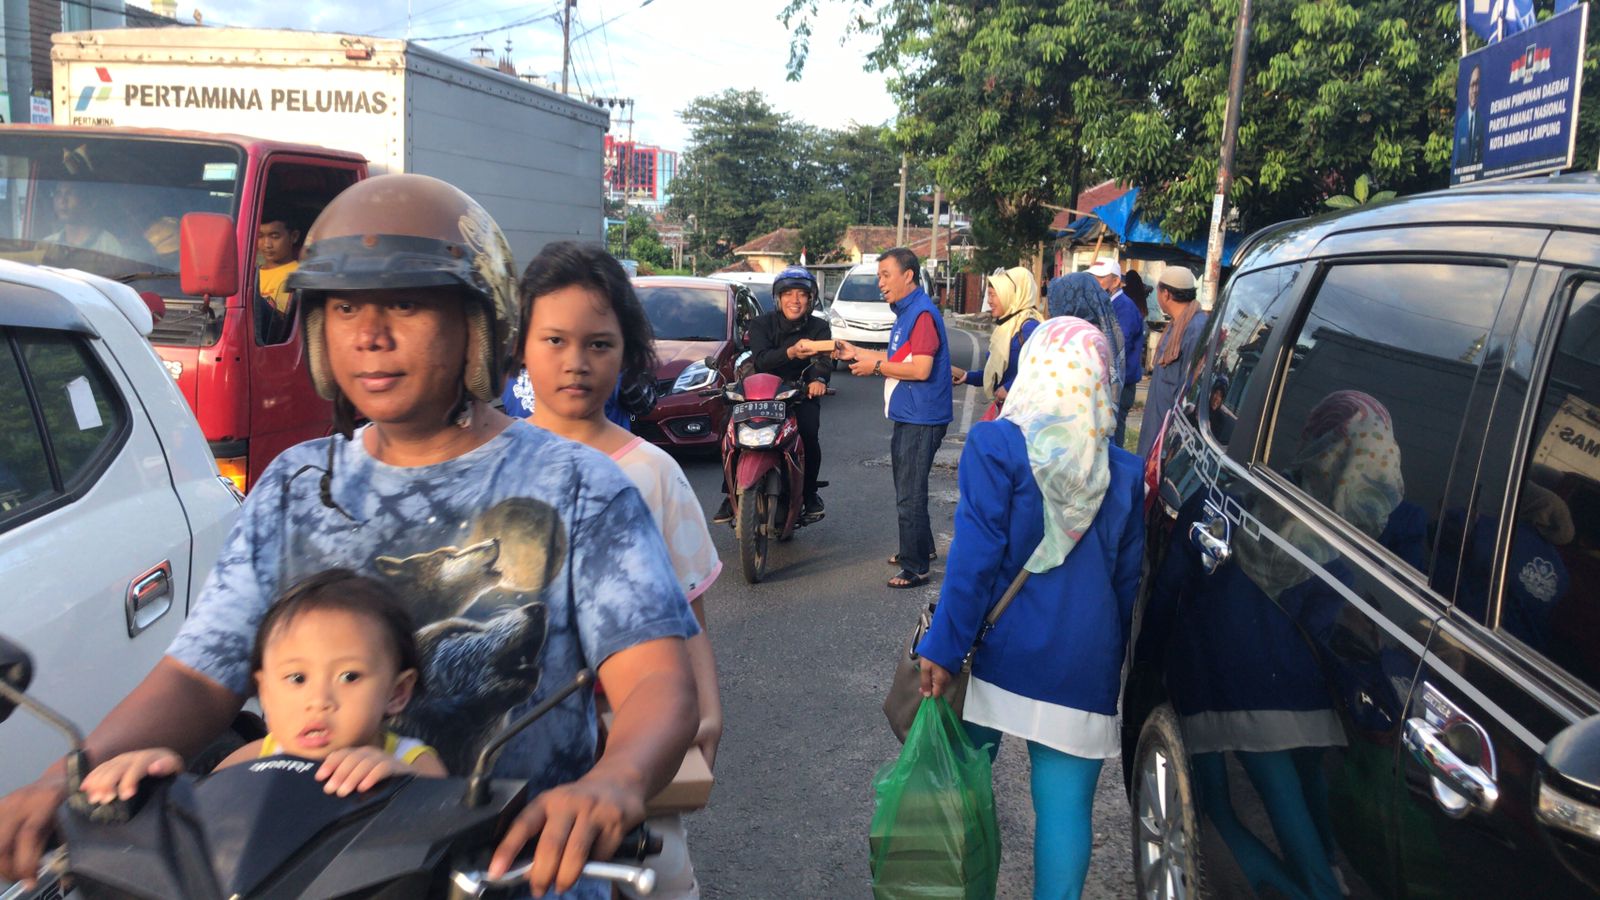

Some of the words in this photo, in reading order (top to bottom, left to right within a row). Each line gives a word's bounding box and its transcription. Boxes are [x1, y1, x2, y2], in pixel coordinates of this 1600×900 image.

[125, 84, 263, 111] PERTAMINA
[271, 89, 388, 115] PELUMAS
[1490, 97, 1511, 114] DEWAN
[1512, 87, 1541, 108] PIMPINAN
[1542, 76, 1570, 99] DAERAH
[73, 116, 114, 126] PERTAMINA
[1489, 115, 1509, 133] PARTAI
[1509, 108, 1534, 127] AMANAT
[1533, 98, 1567, 121] NASIONAL
[1489, 135, 1503, 151] KOTA
[1504, 129, 1528, 148] BANDAR
[1529, 121, 1560, 141] LAMPUNG
